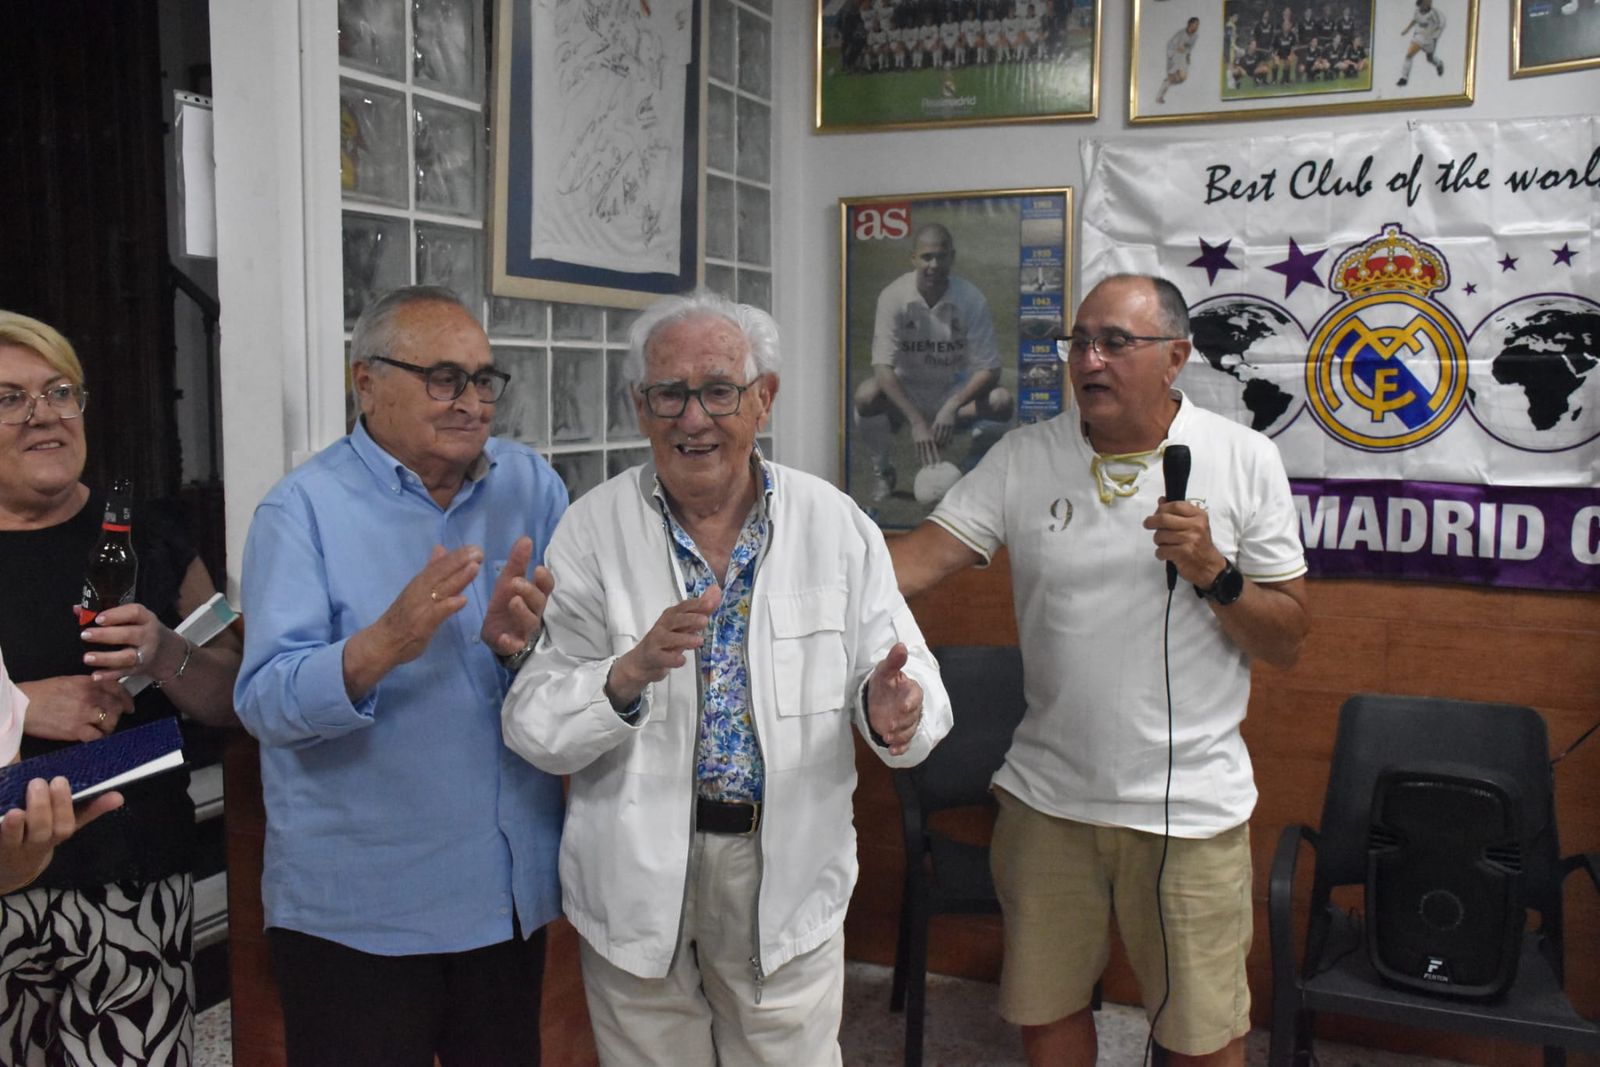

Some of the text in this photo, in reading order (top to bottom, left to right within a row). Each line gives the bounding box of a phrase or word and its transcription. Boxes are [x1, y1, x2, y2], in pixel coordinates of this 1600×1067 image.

[1204, 145, 1600, 206] Best Club of the worl
[855, 207, 909, 241] as
[1048, 497, 1074, 533] 9
[1293, 494, 1545, 561] MADRID
